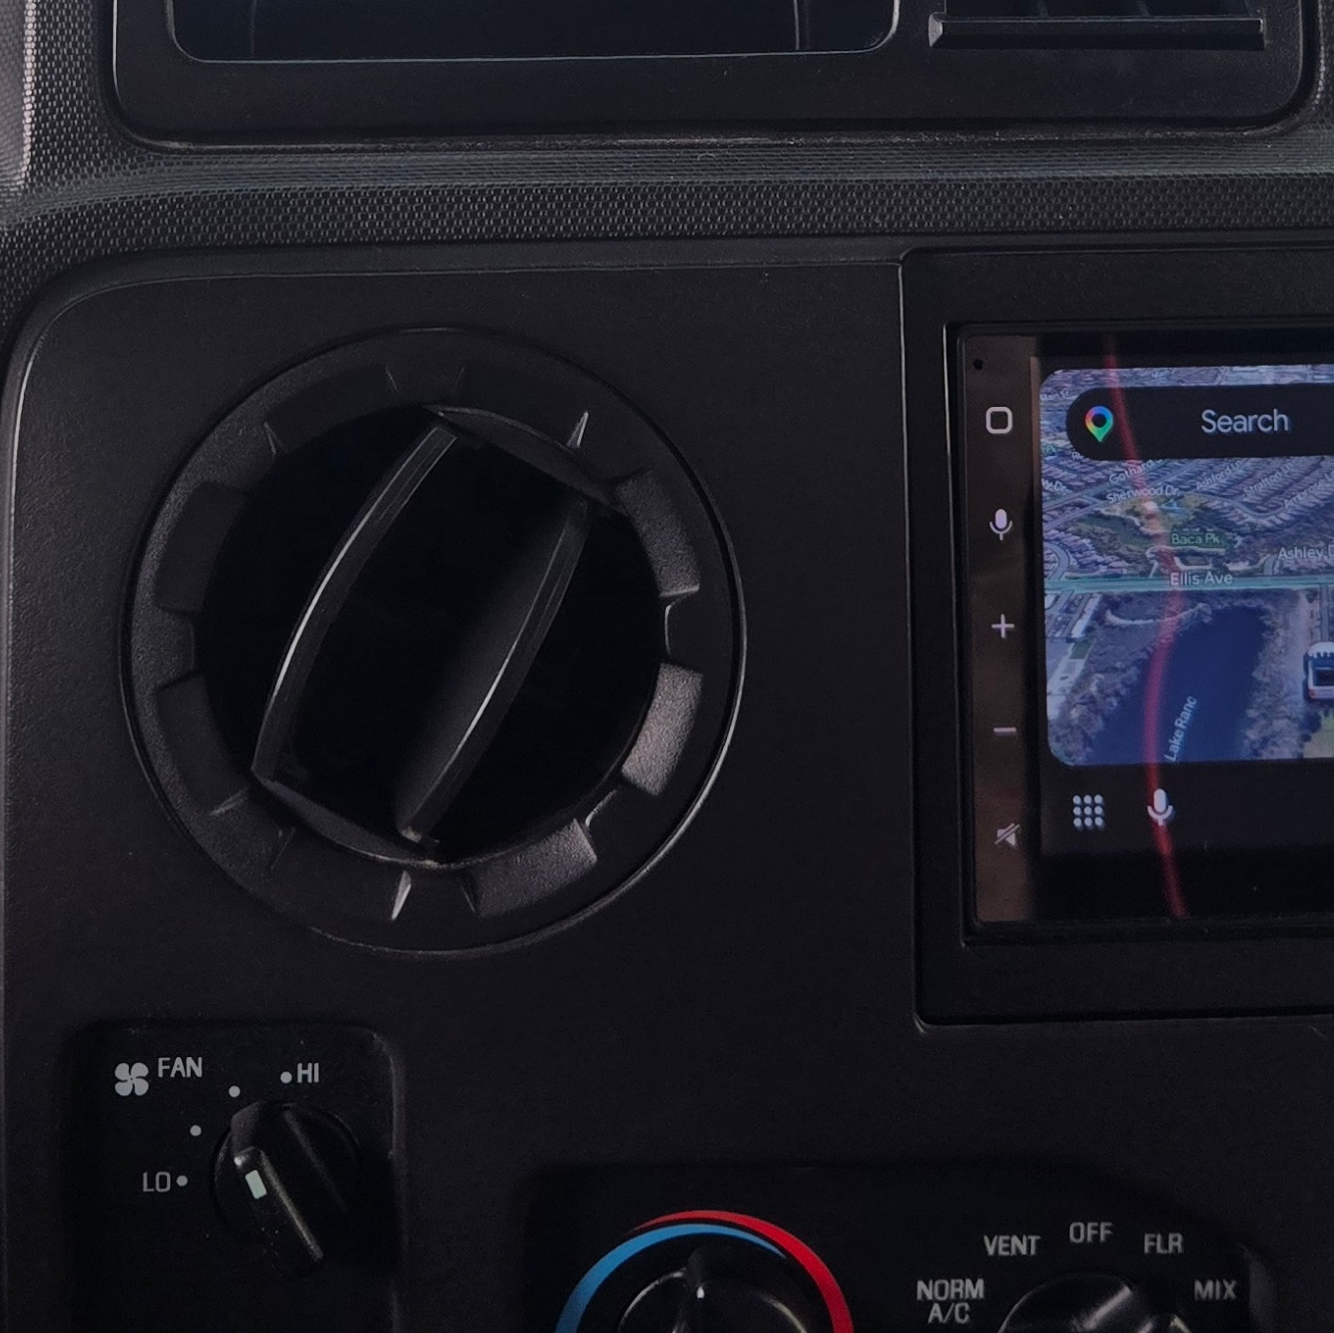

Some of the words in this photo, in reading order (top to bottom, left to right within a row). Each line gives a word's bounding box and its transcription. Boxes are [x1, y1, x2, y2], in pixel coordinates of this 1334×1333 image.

[1201, 409, 1290, 434] Search
[1106, 486, 1163, 503] Sherwood
[1166, 485, 1179, 496] Dr
[1171, 533, 1202, 544] Baca
[1277, 546, 1322, 561] Ashley
[1170, 572, 1201, 585] Ellis
[1204, 571, 1234, 584] Ave
[1164, 728, 1185, 762] Lake
[158, 1057, 203, 1078] FAN
[297, 1063, 319, 1083] HI
[142, 1171, 171, 1192] LO
[1069, 1222, 1113, 1243] OFF
[983, 1234, 1041, 1256] VENT
[1144, 1233, 1183, 1254] FLR
[916, 1278, 984, 1301] NORM
[1194, 1280, 1237, 1300] MIX
[928, 1302, 970, 1324] A/C
